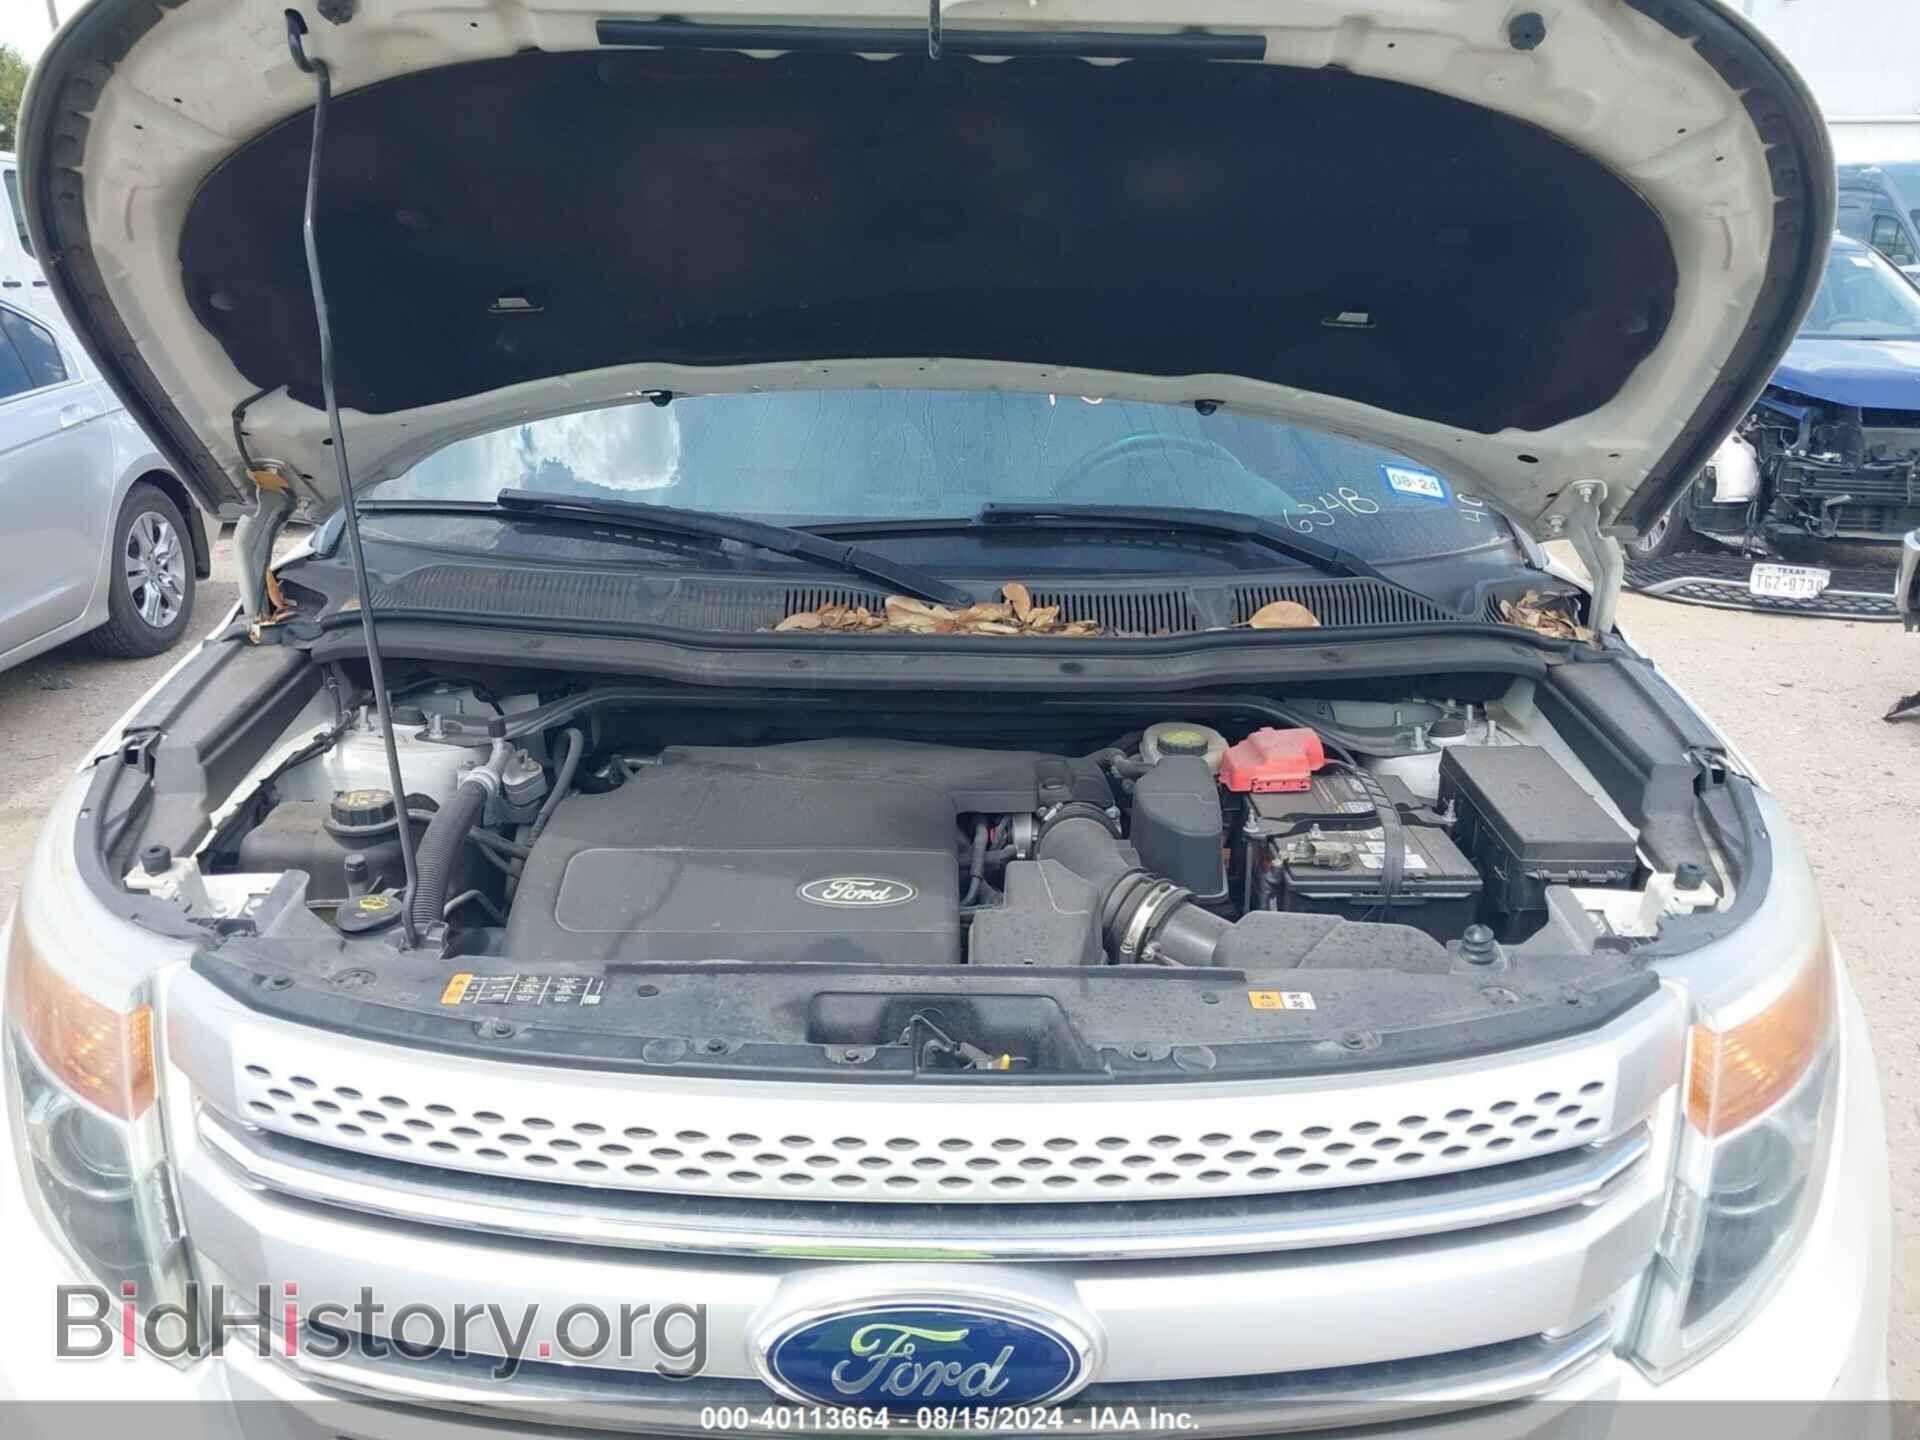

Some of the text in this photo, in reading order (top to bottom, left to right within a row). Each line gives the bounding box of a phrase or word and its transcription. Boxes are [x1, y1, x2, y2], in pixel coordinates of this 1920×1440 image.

[1283, 486, 1380, 534] 6348
[1777, 567, 1806, 575] TEXAS
[822, 880, 892, 901] Ford
[831, 1323, 1016, 1398] Ford
